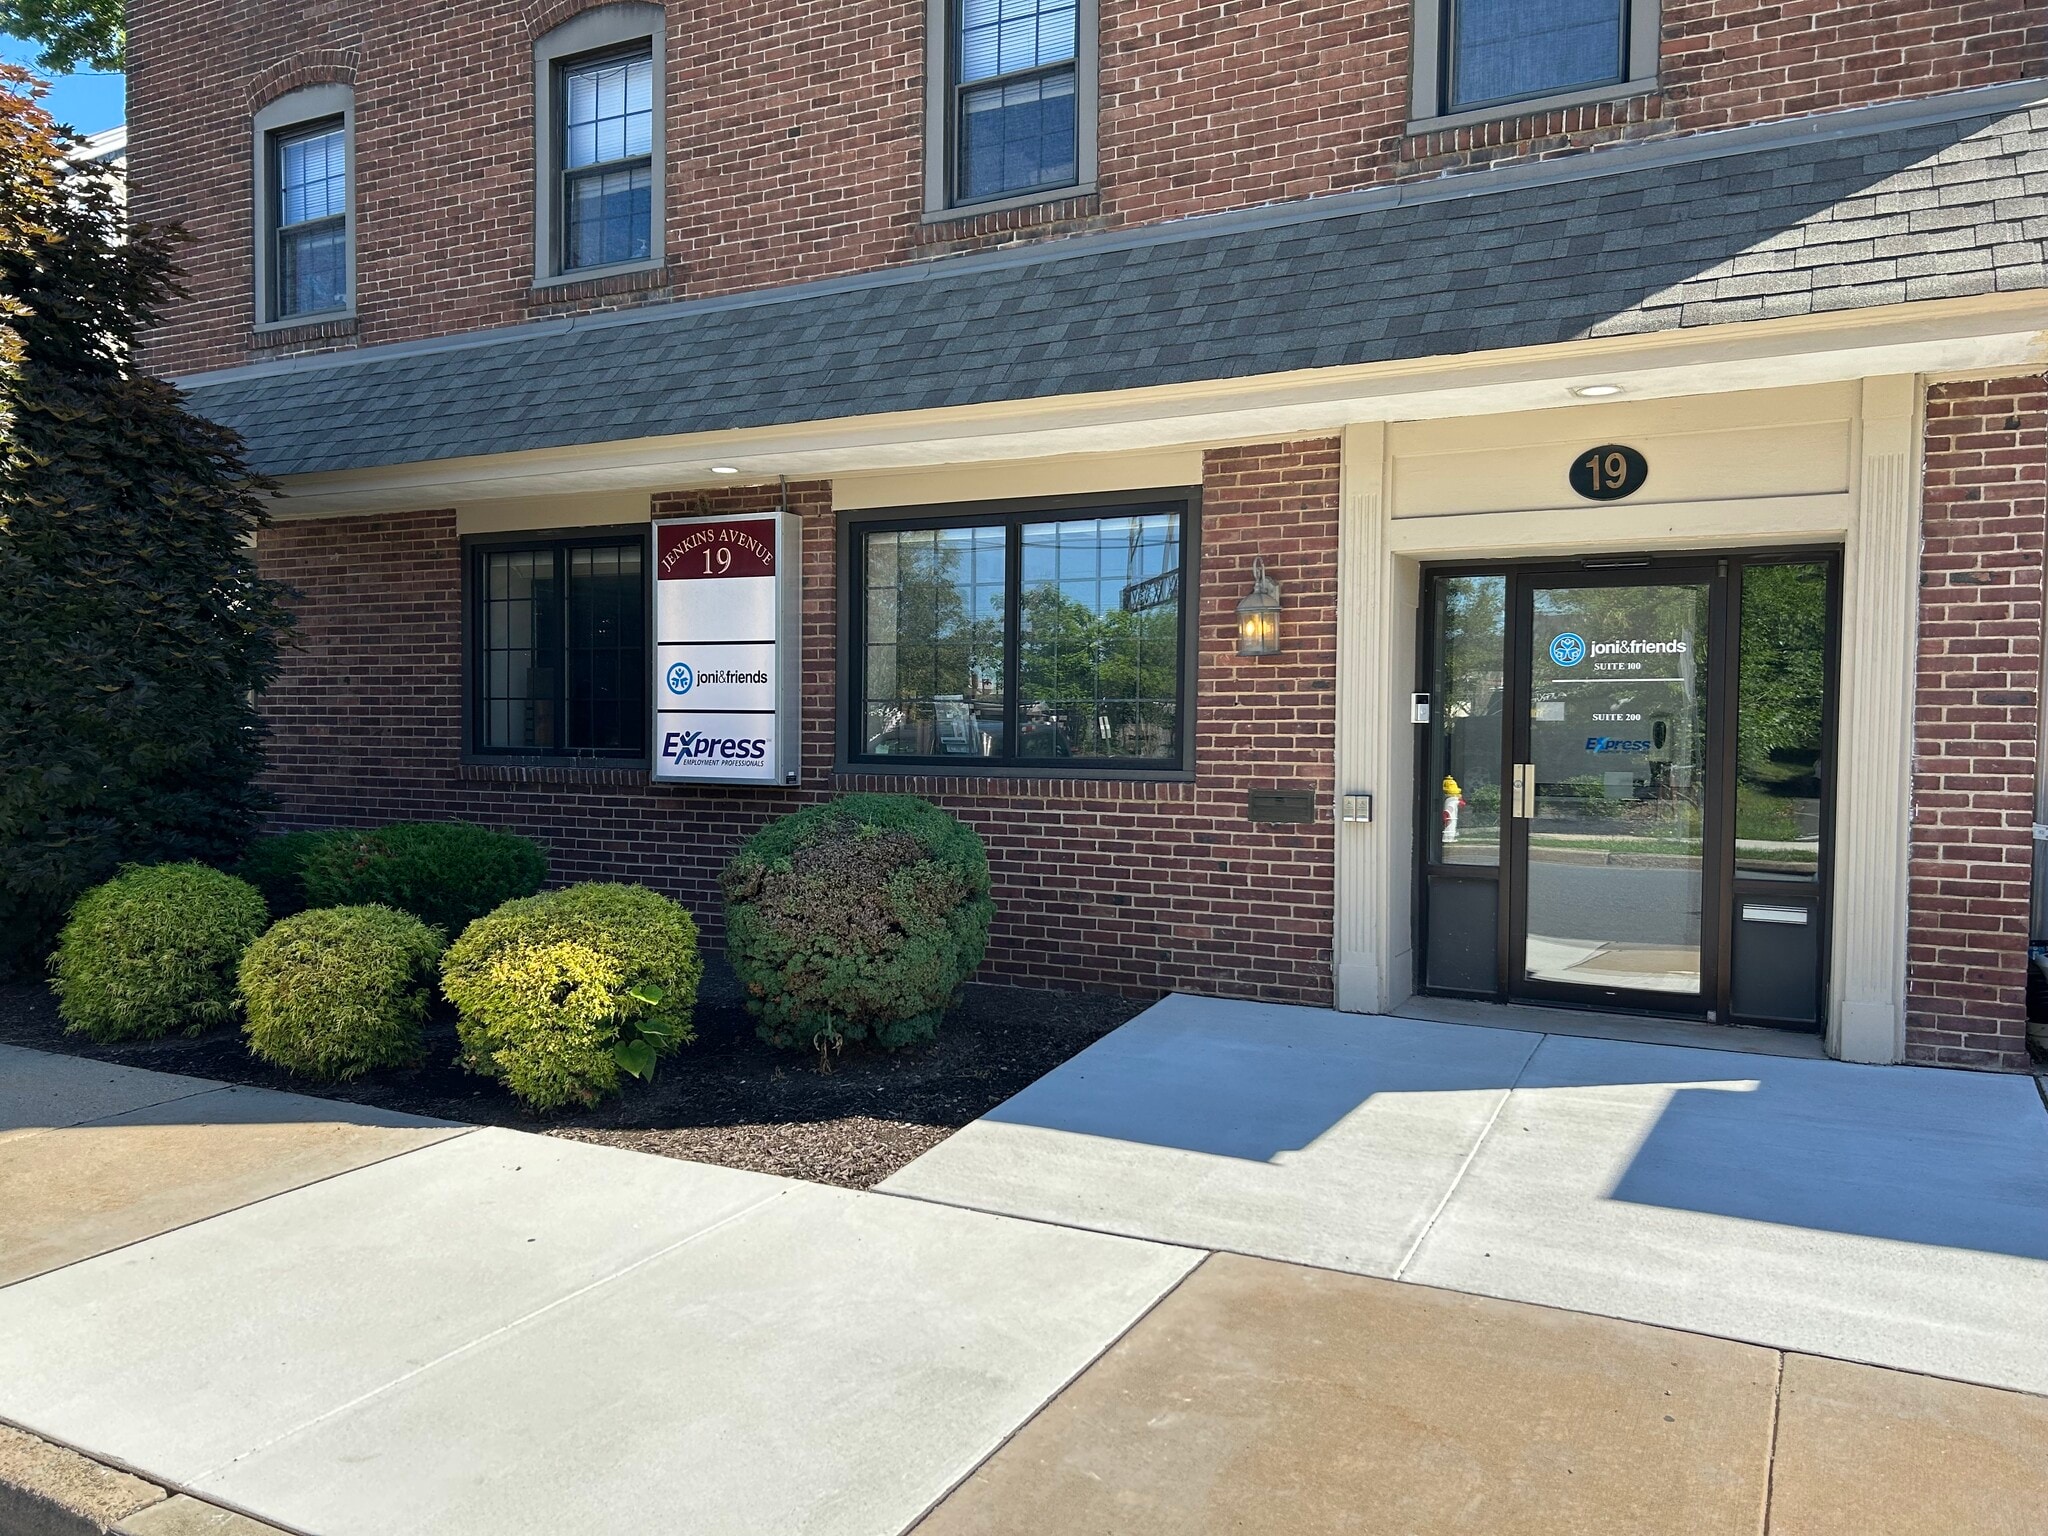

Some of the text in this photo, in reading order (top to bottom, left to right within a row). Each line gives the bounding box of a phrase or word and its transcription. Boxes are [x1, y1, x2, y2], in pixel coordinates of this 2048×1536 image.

[1585, 452, 1627, 491] 19
[661, 529, 774, 573] JENKINS AVENUE
[702, 547, 732, 574] 19
[1590, 639, 1687, 657] joni&friends
[1594, 662, 1641, 670] SUITE 100
[697, 669, 768, 687] joni&friends
[1592, 713, 1641, 721] SUITE 200
[683, 759, 764, 767] EMPLOYMENT PROFESSIONALS
